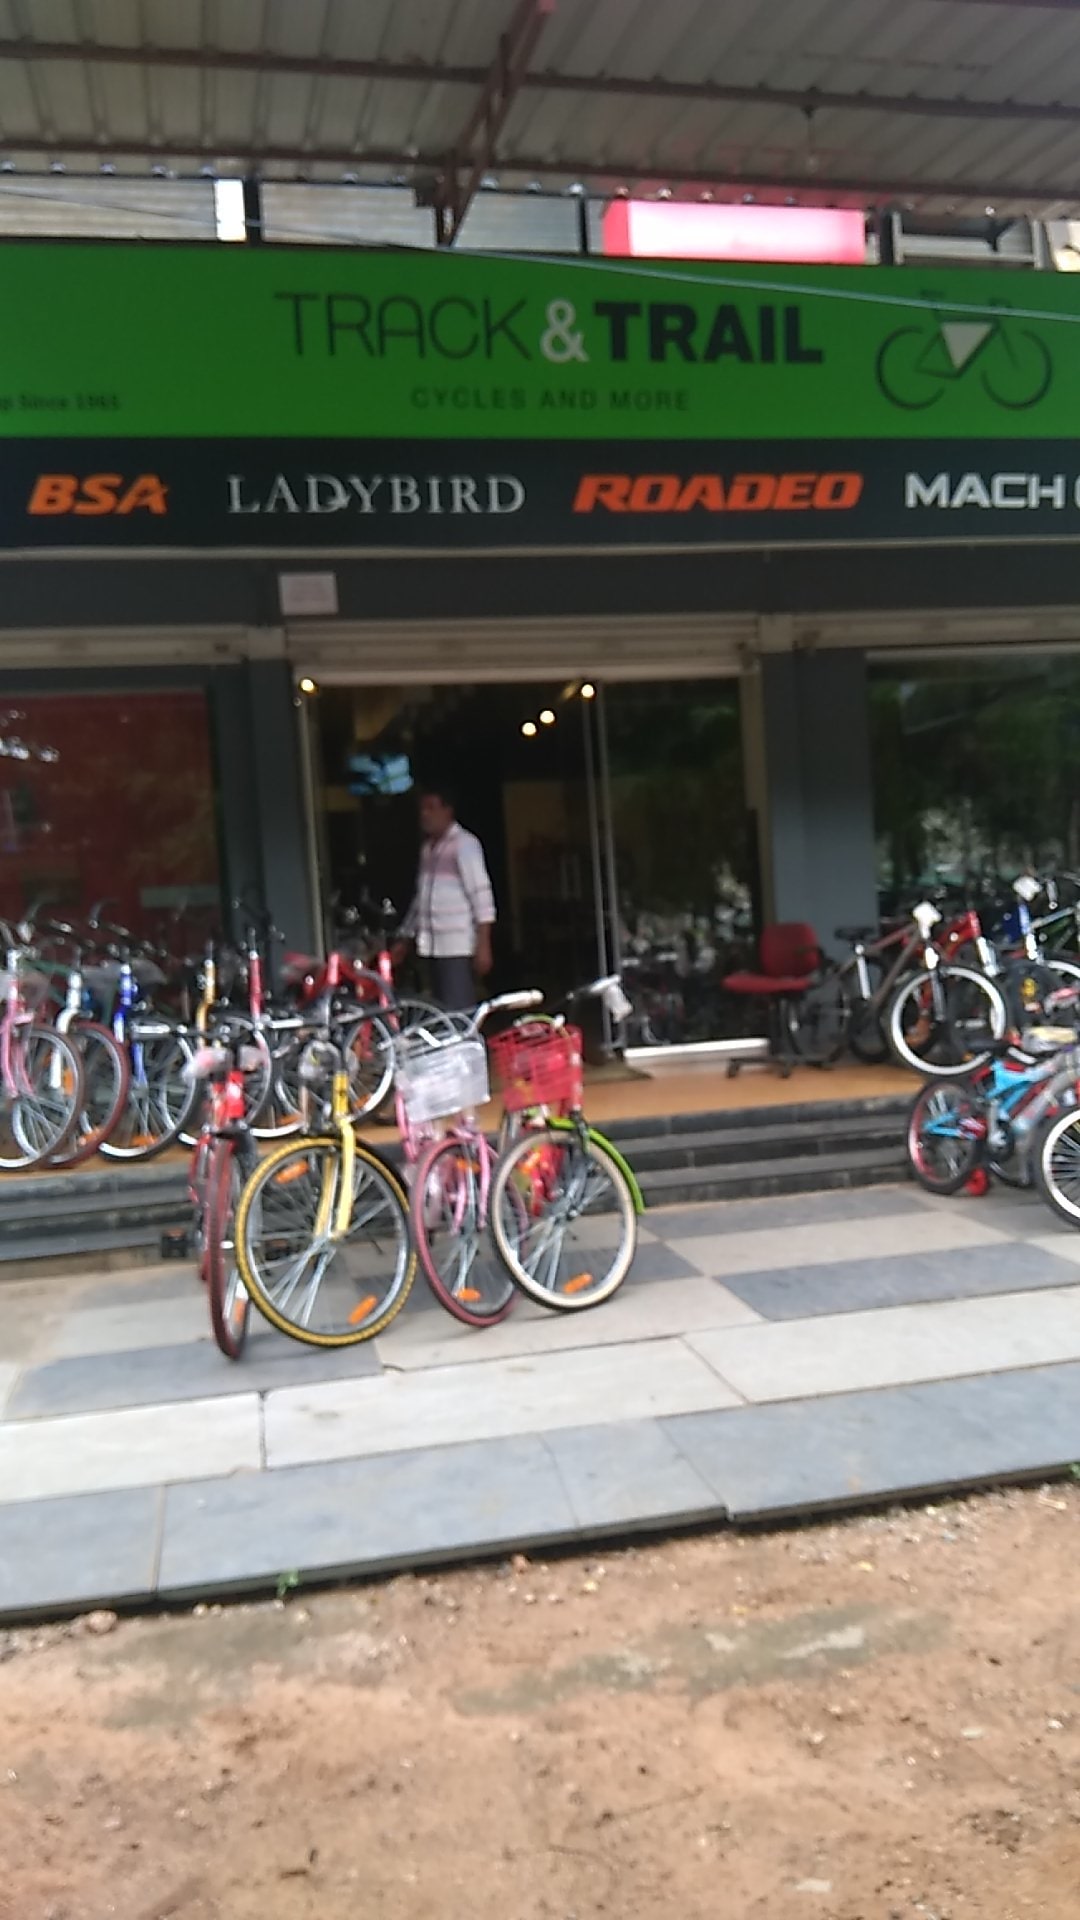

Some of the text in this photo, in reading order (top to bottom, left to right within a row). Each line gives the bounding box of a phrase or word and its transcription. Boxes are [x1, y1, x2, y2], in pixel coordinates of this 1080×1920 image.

[410, 387, 689, 412] CYCLES AND MORE
[27, 472, 169, 515] BSA
[226, 473, 526, 514] LADYBIRD
[572, 472, 864, 514] ROADEO
[904, 472, 1066, 510] MACH
